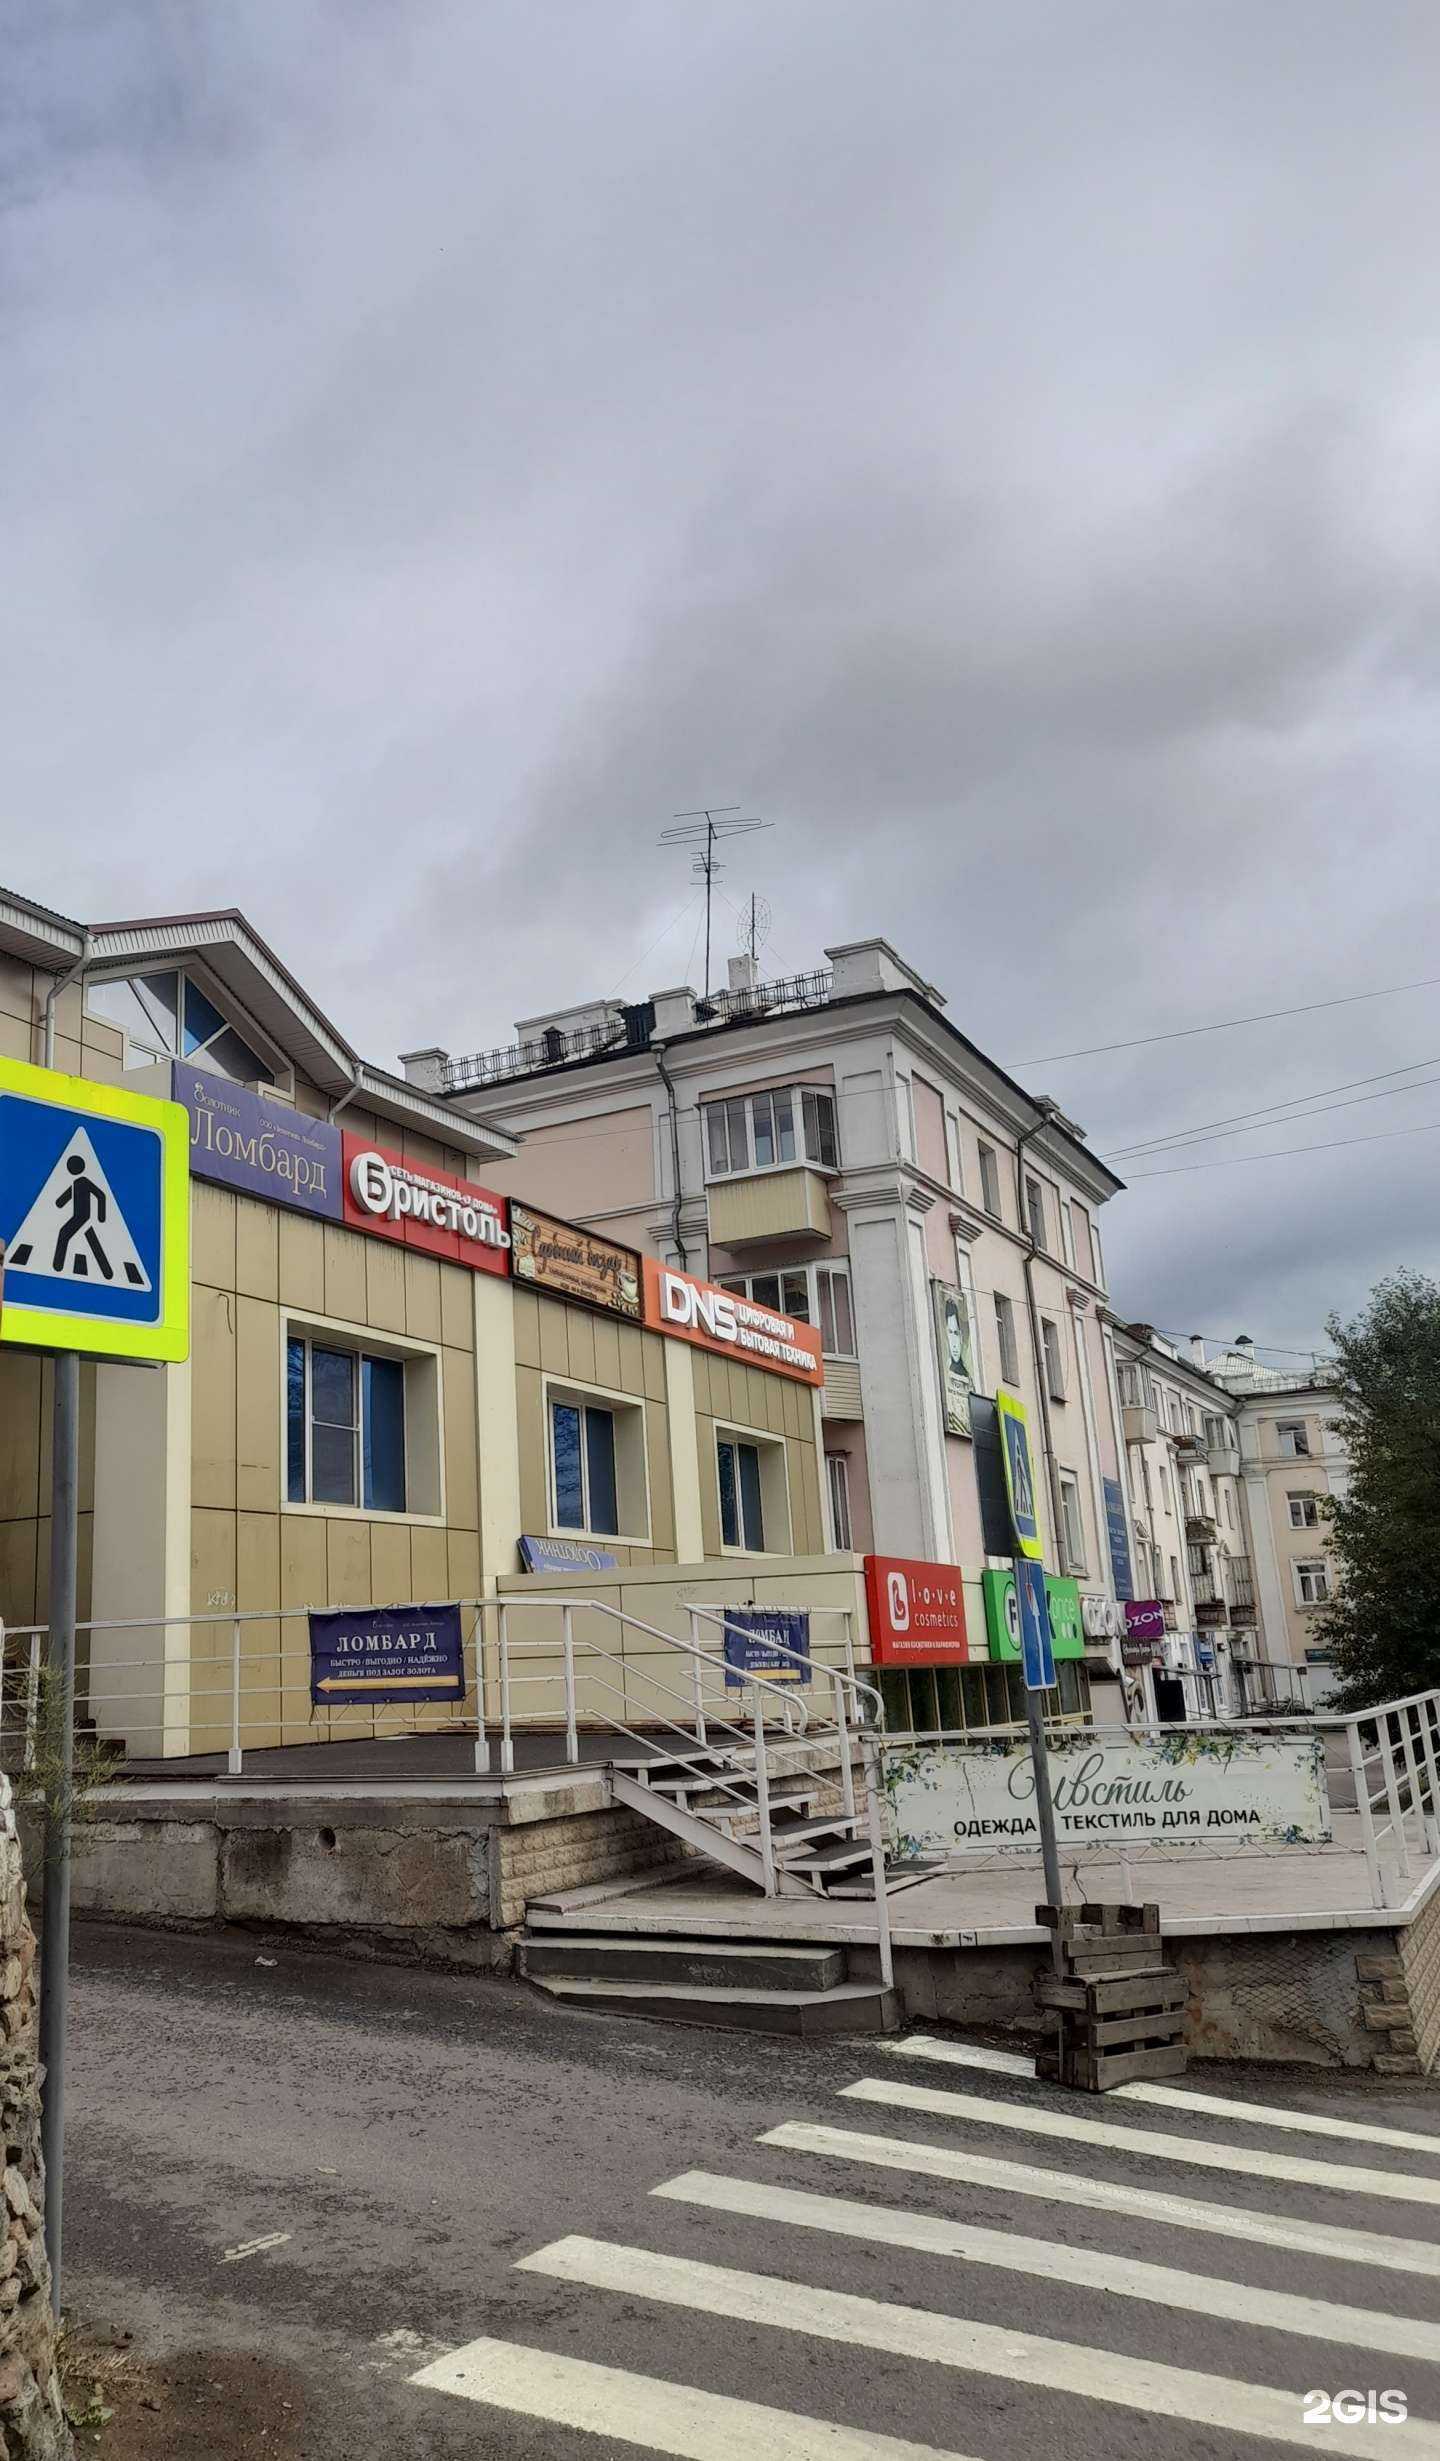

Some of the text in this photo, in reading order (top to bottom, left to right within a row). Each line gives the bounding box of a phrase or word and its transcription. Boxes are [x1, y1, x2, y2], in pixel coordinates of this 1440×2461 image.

[190, 1107, 327, 1199] Ломбард
[390, 1165, 413, 1181] СЕТЬ
[350, 1152, 511, 1249] Бристоль
[659, 1272, 738, 1342] DNS
[738, 1302, 786, 1337] ЦИФРОВАЯ
[739, 1327, 817, 1371] БЫТОВАЯ ТЕХНИКА
[914, 1611, 959, 1628] cosmetics
[336, 1632, 437, 1653] ЛОМБАРД
[330, 1658, 361, 1667] БЫСТРО
[366, 1657, 402, 1666] ВЫГОДНО
[408, 1654, 448, 1664] НАДЁЖНО
[338, 1667, 436, 1678] ДЕНЬГИ ПОД ЗАЛОГ ЗОЛОТА
[953, 1809, 1261, 1837] ОДЕЖДА ТЕКСТИЛЬ ДЛЯ ДОМА
